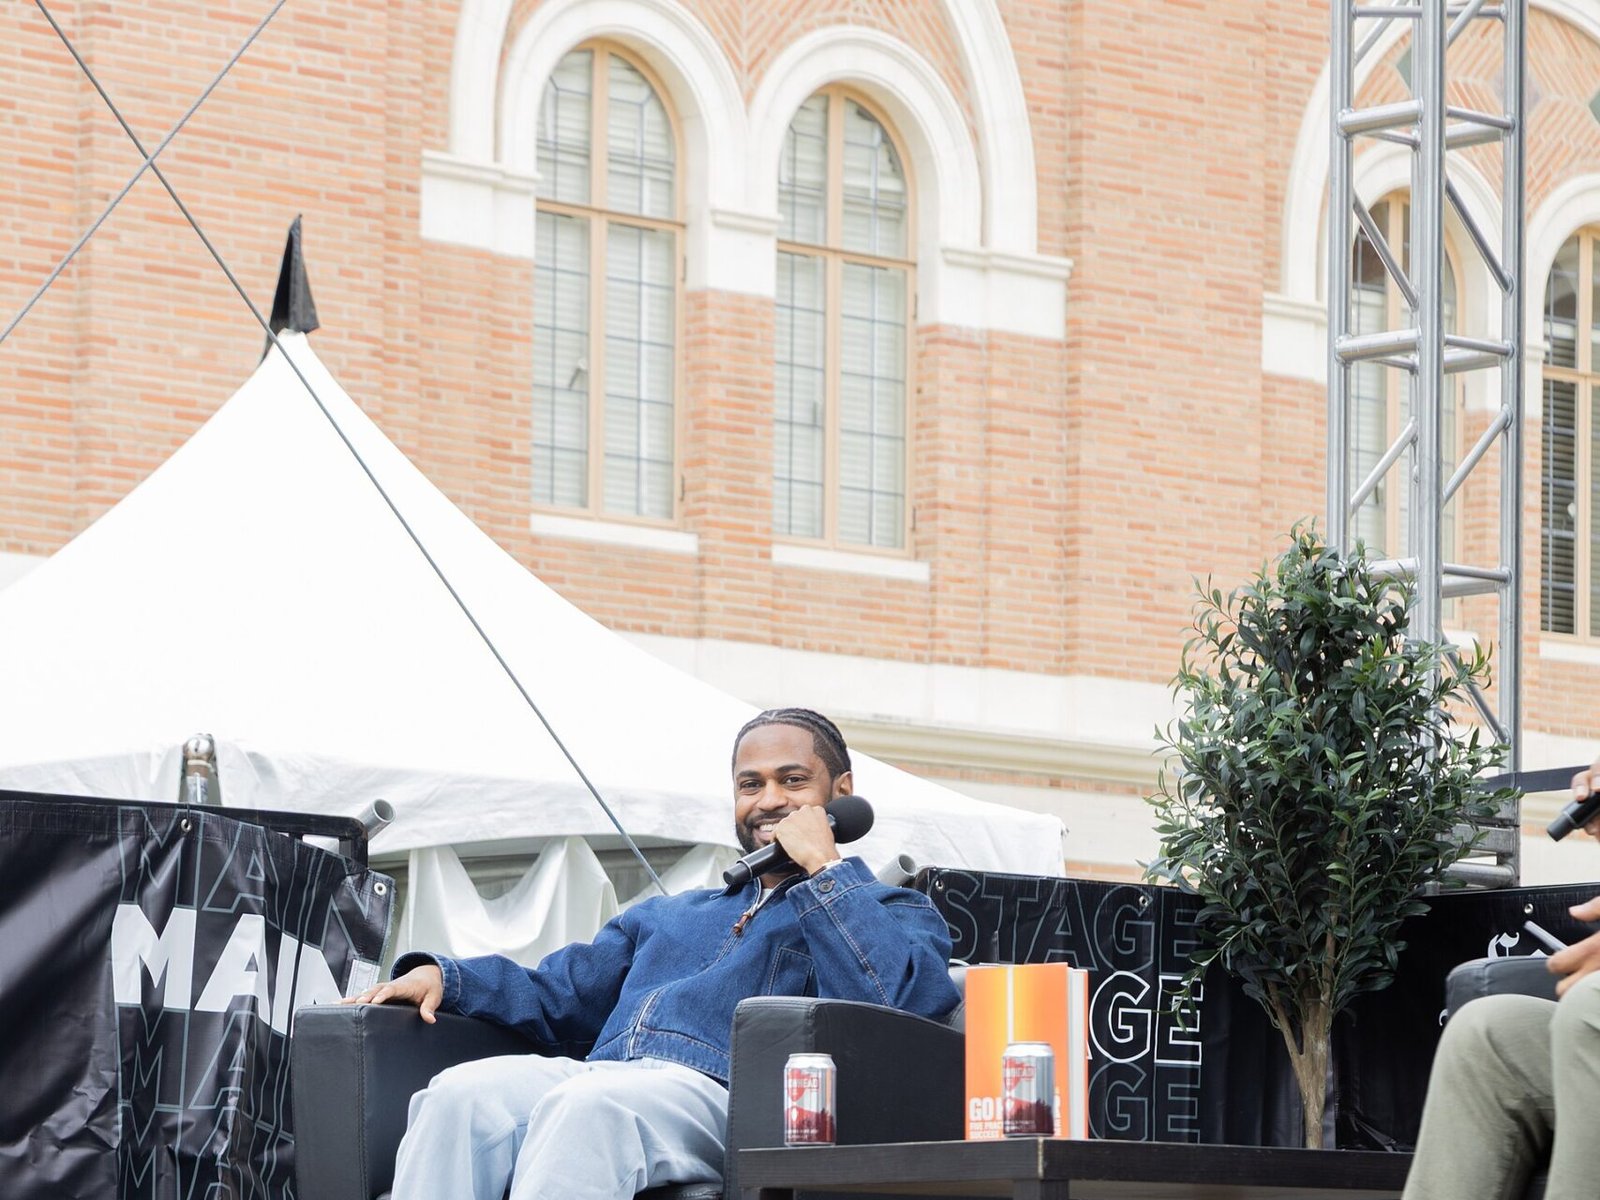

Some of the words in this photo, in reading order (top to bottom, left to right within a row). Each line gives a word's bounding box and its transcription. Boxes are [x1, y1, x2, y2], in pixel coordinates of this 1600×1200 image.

[117, 805, 395, 967] MAIN
[928, 869, 1201, 976] STAGE
[111, 904, 381, 1038] MAIN
[116, 1002, 295, 1139] MAI
[970, 1096, 994, 1120] GO
